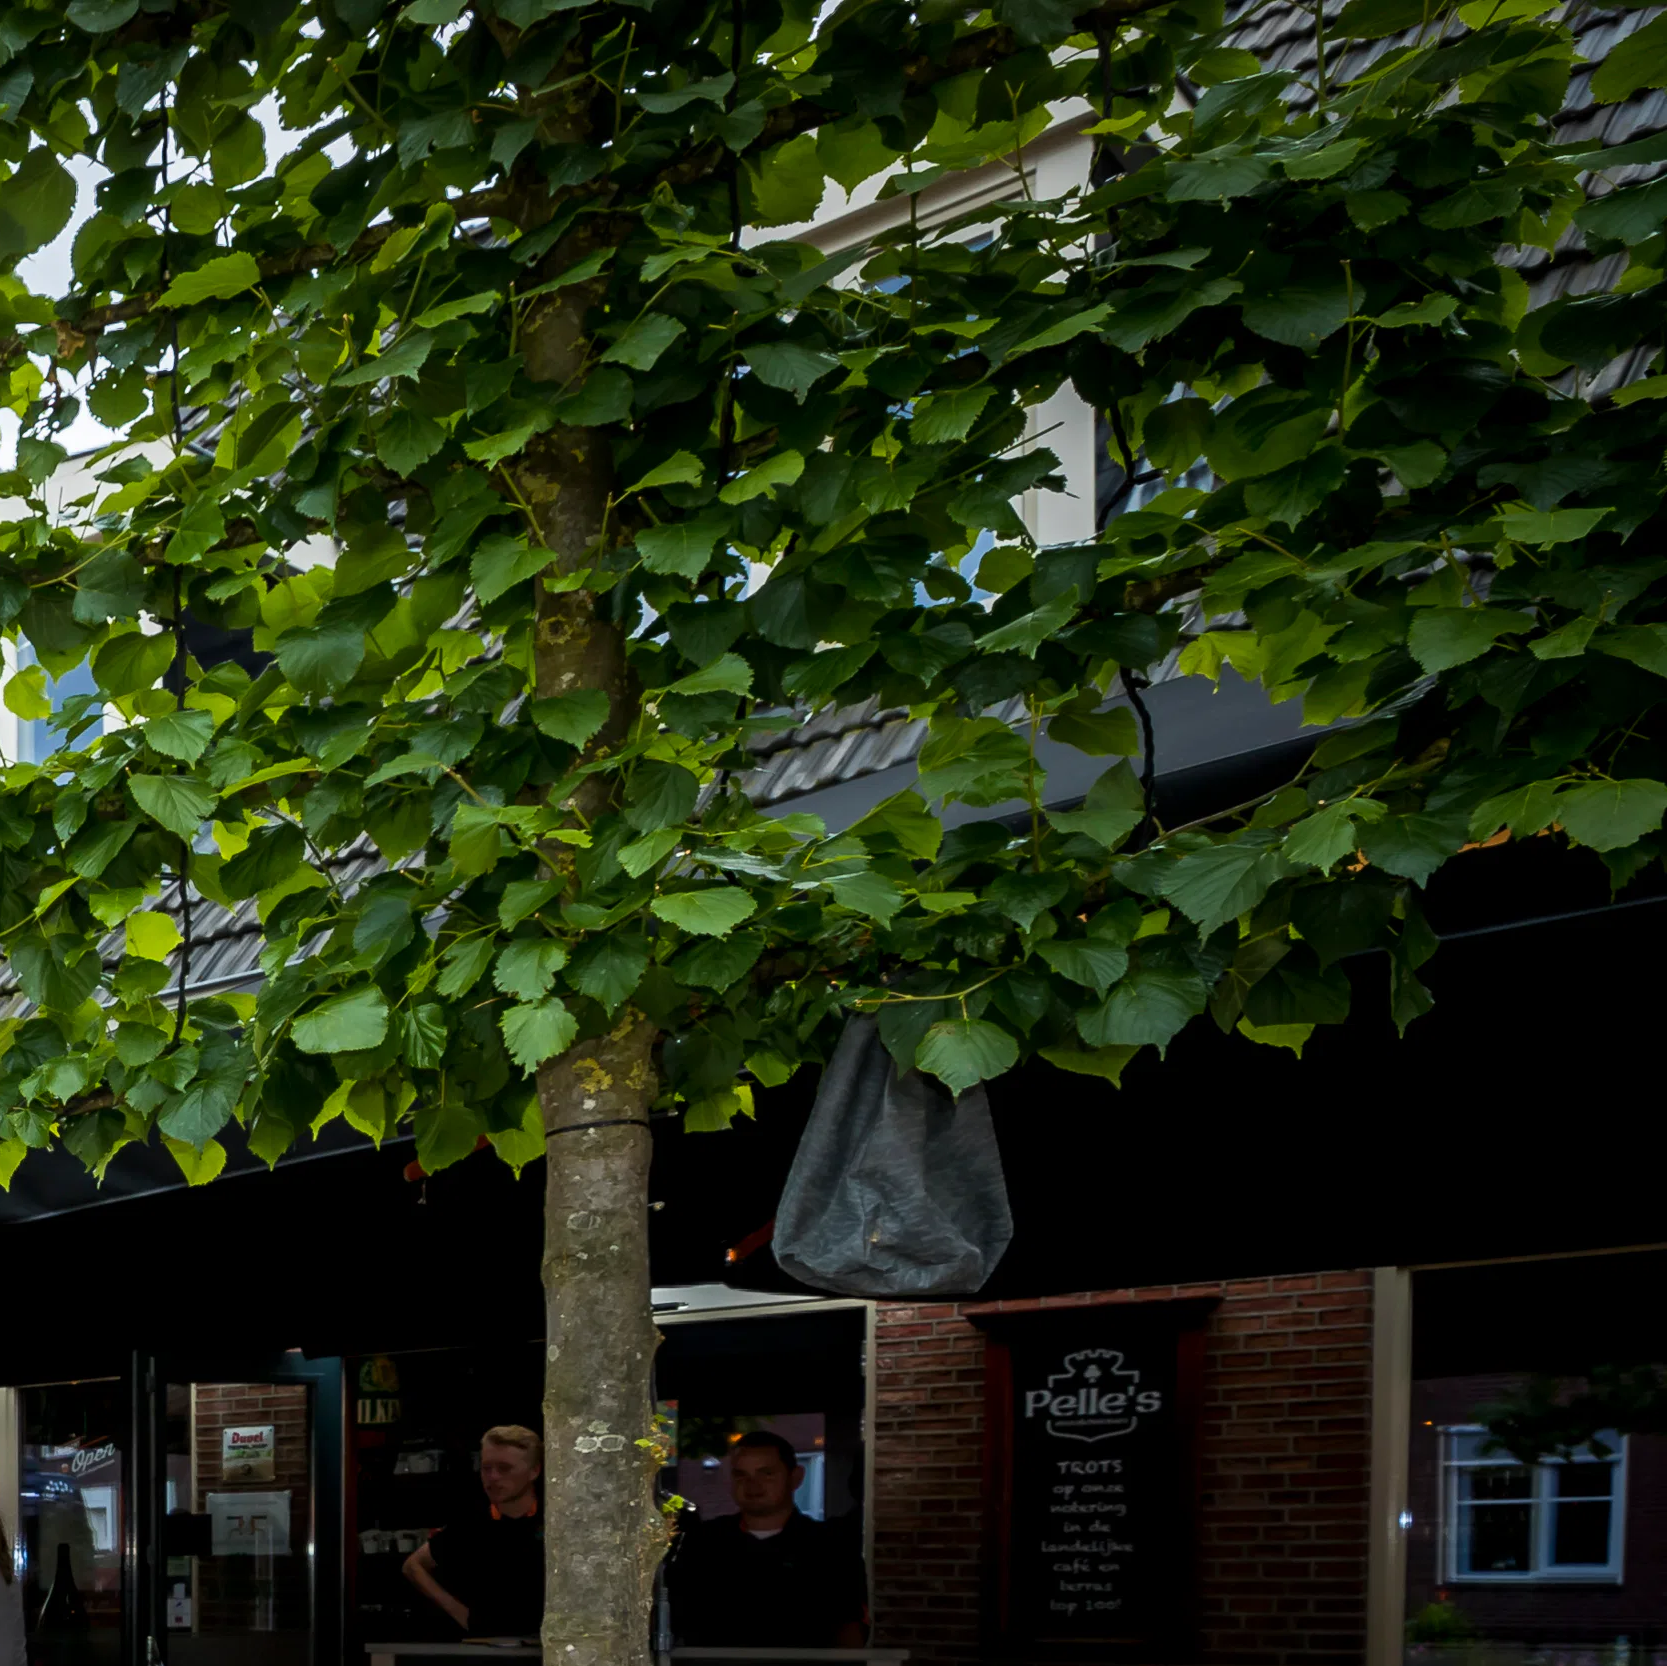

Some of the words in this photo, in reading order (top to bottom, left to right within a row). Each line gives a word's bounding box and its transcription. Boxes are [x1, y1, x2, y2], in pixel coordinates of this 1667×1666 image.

[1024, 1385, 1163, 1419] Pelle's
[231, 1431, 264, 1444] Duvel
[71, 1443, 115, 1473] Open
[1056, 1459, 1123, 1476] TROTS
